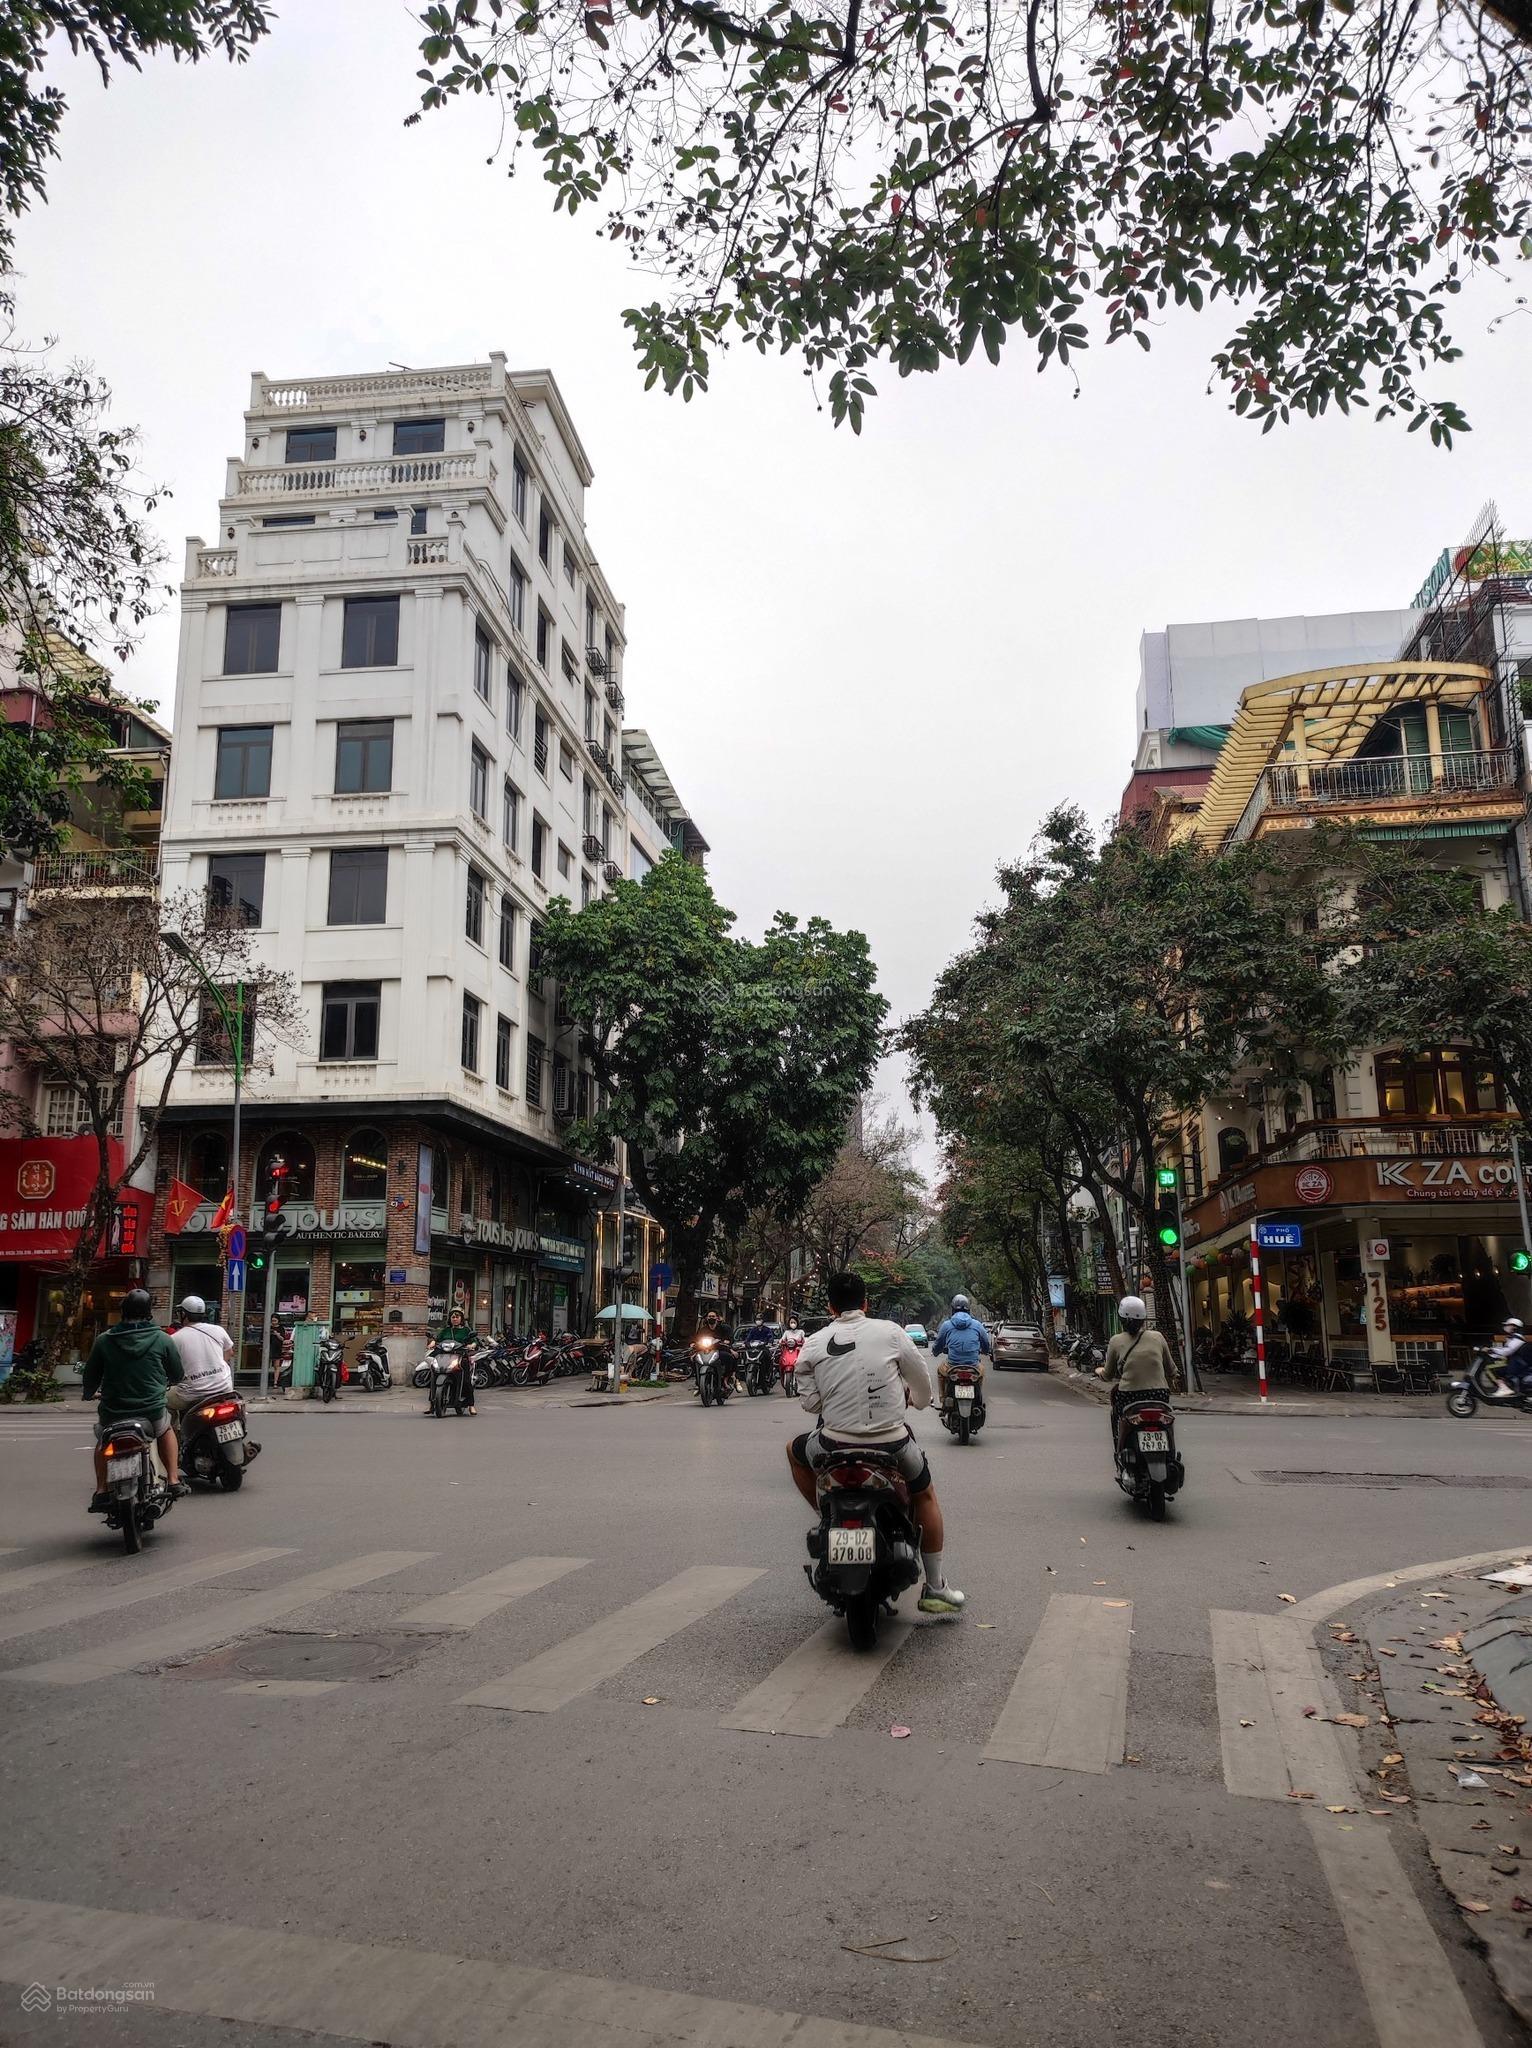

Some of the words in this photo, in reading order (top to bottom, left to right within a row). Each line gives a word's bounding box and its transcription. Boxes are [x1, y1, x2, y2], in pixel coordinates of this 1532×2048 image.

[1160, 1173, 1174, 1184] 30
[11, 1209, 36, 1230] SÂM
[39, 1208, 62, 1229] HÀN
[296, 1231, 348, 1240] AUTHENTIC
[349, 1230, 382, 1239] BAKERY
[477, 1219, 500, 1244] TOUS
[512, 1228, 539, 1252] JOURS
[1263, 1233, 1295, 1244] HUẾ
[832, 1547, 872, 1562] 378.08
